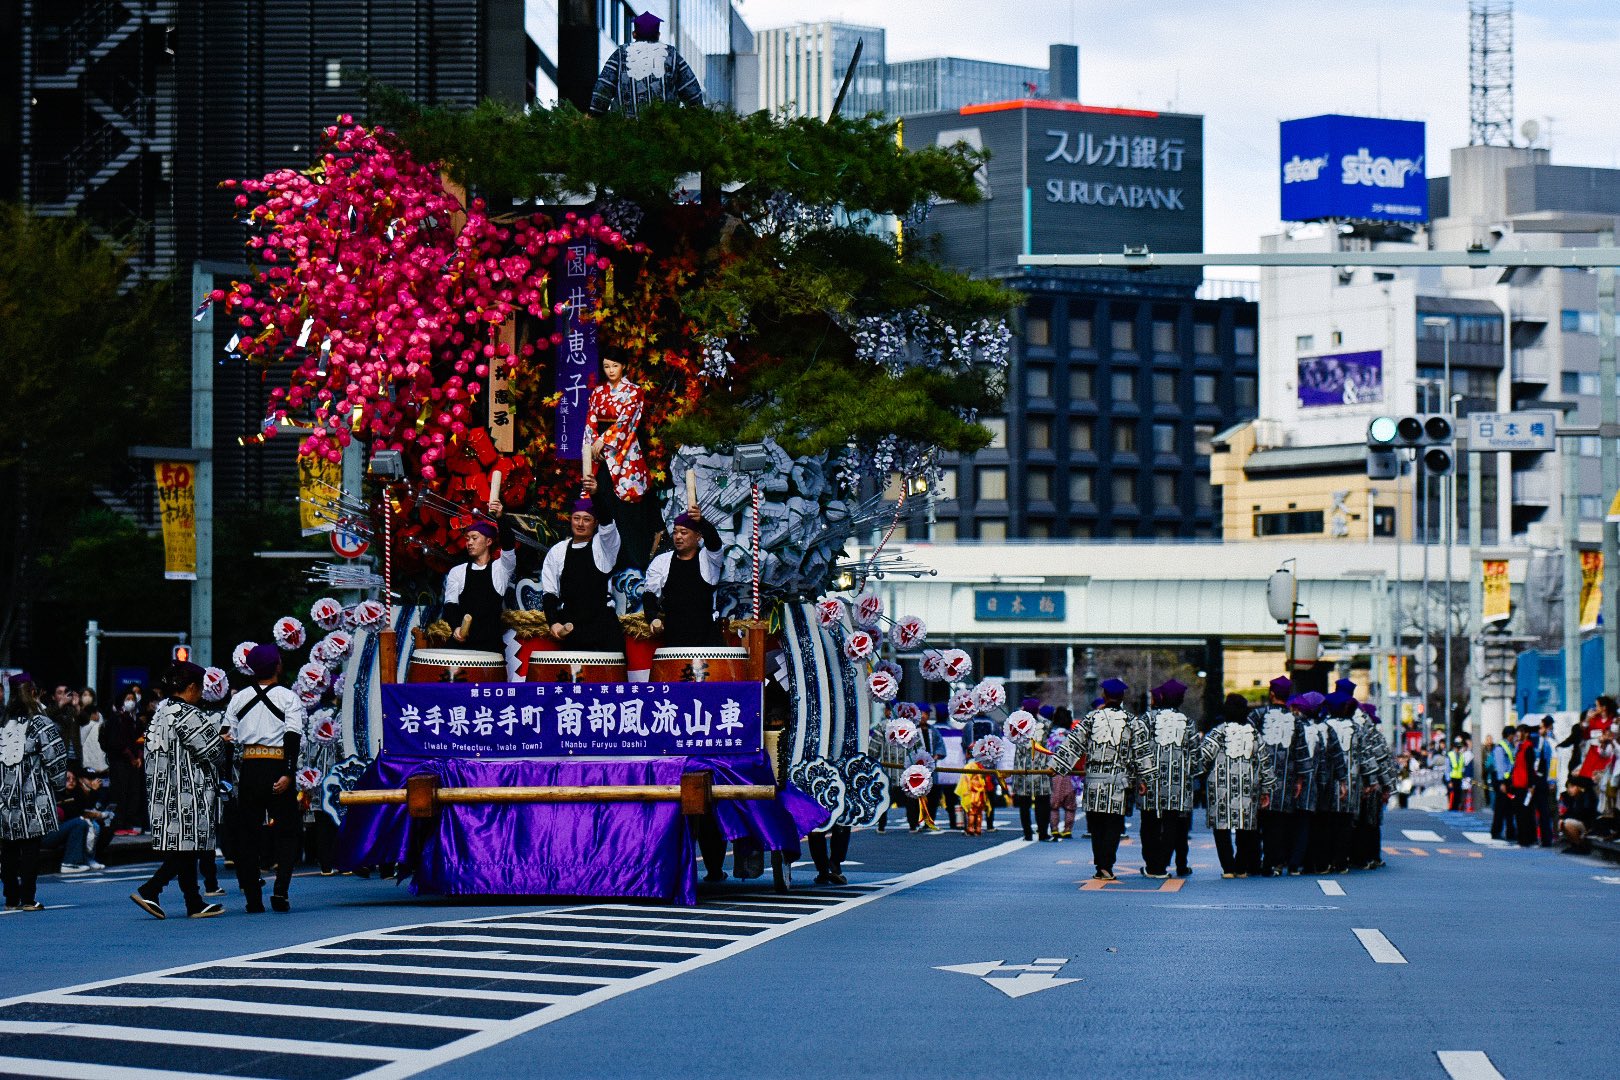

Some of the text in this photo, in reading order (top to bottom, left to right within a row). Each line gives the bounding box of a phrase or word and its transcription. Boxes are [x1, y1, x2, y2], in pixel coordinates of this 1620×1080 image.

[1045, 129, 1185, 171] スルガ銀行
[1341, 147, 1412, 189] star
[566, 245, 588, 408] 園井恵子
[560, 396, 569, 453] 生誕110年
[1480, 422, 1545, 438] 日本橋
[161, 462, 191, 489] 50
[470, 685, 670, 698] 第50回 日本橋・京橋まつり
[400, 697, 744, 738] 岩手県岩手町 南部風流山車
[452, 742, 493, 751] Prefecture,
[591, 740, 618, 750] Furyuu
